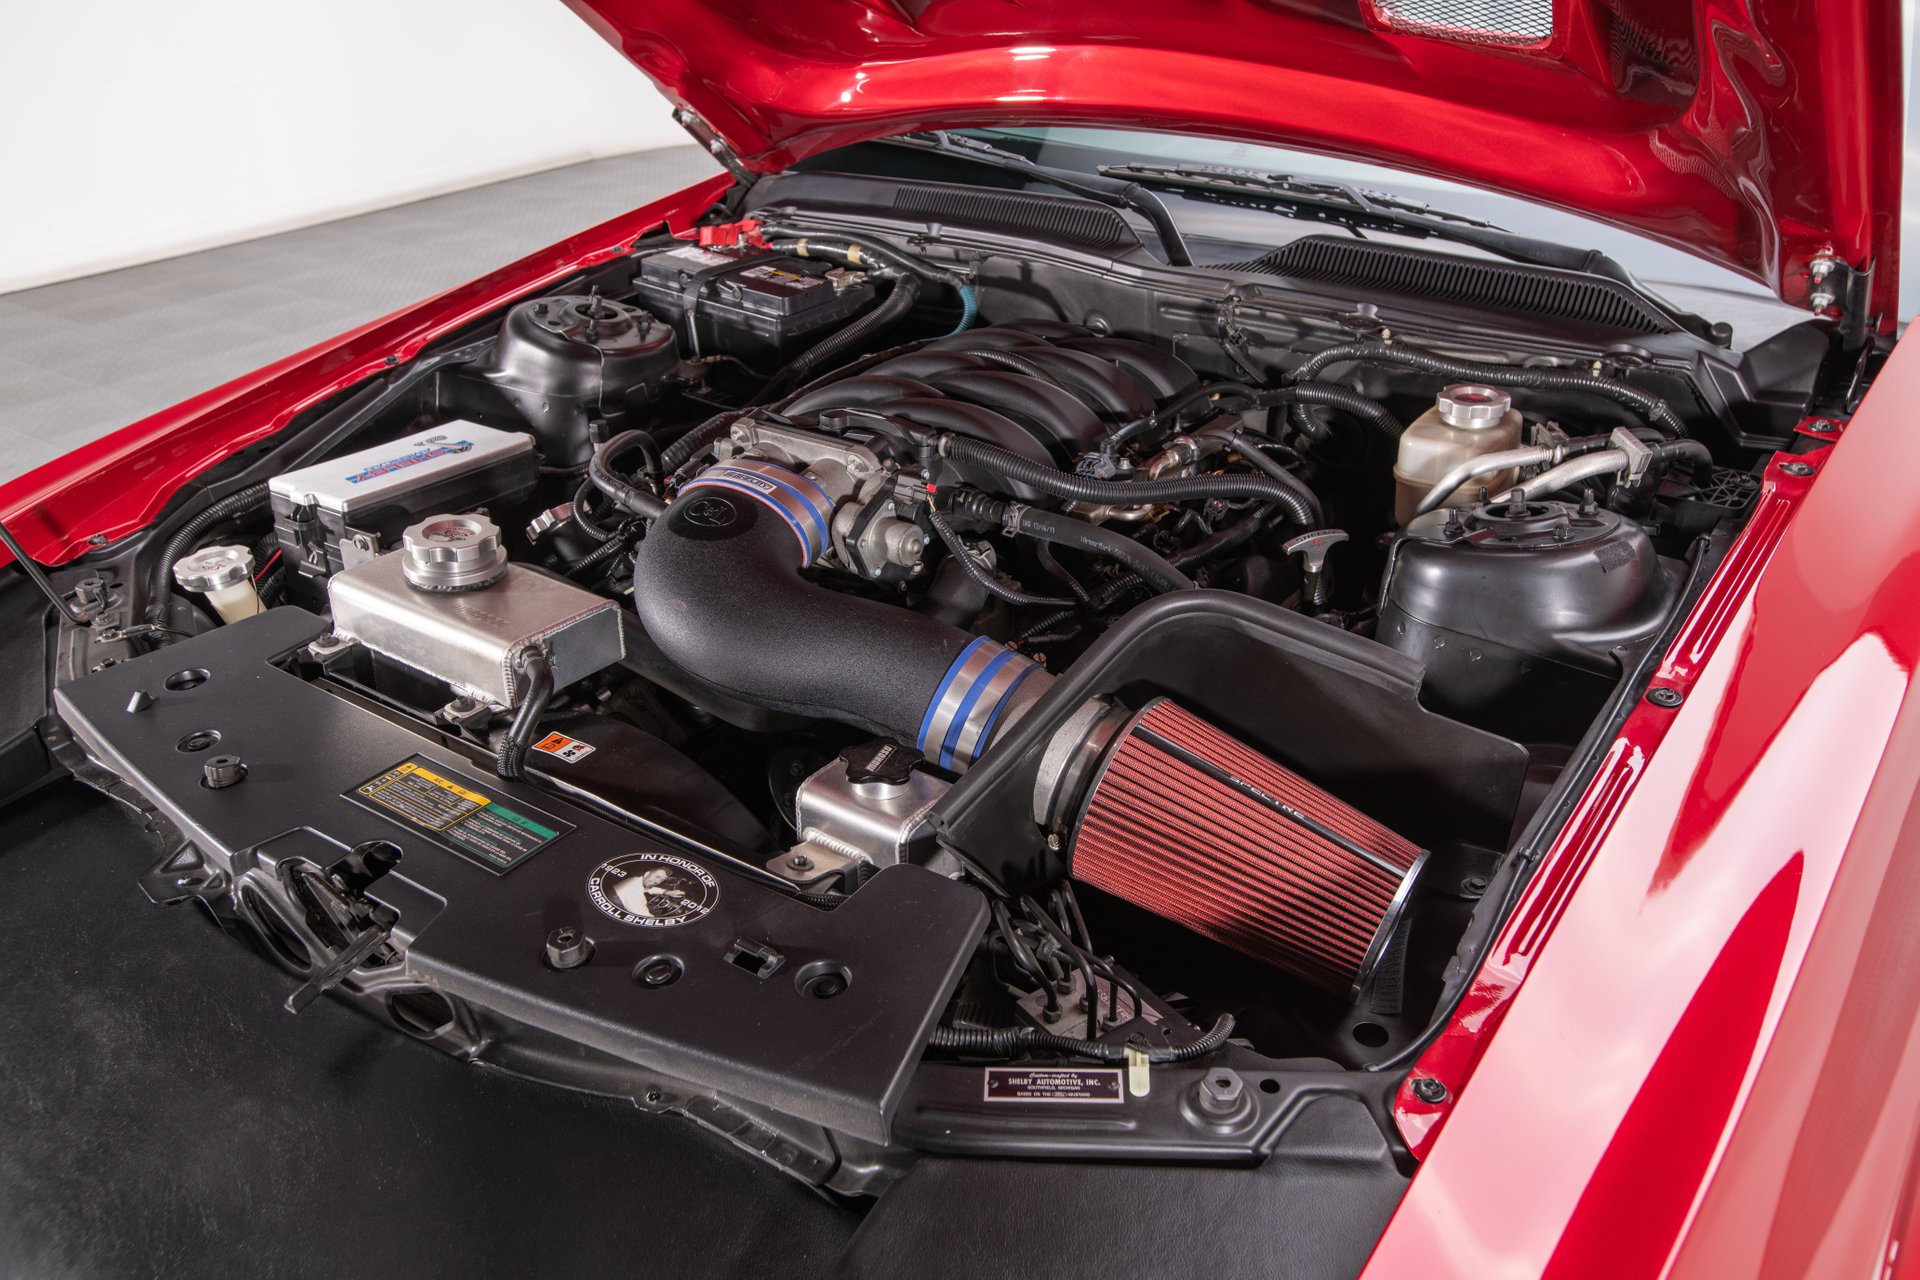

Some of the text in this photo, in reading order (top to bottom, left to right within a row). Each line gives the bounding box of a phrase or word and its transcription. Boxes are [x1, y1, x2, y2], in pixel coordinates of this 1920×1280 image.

[600, 862, 628, 878] 1923
[640, 853, 716, 888] IN HONOR OF
[590, 877, 687, 926] CARROLL SHELBY
[680, 898, 710, 915] 2012
